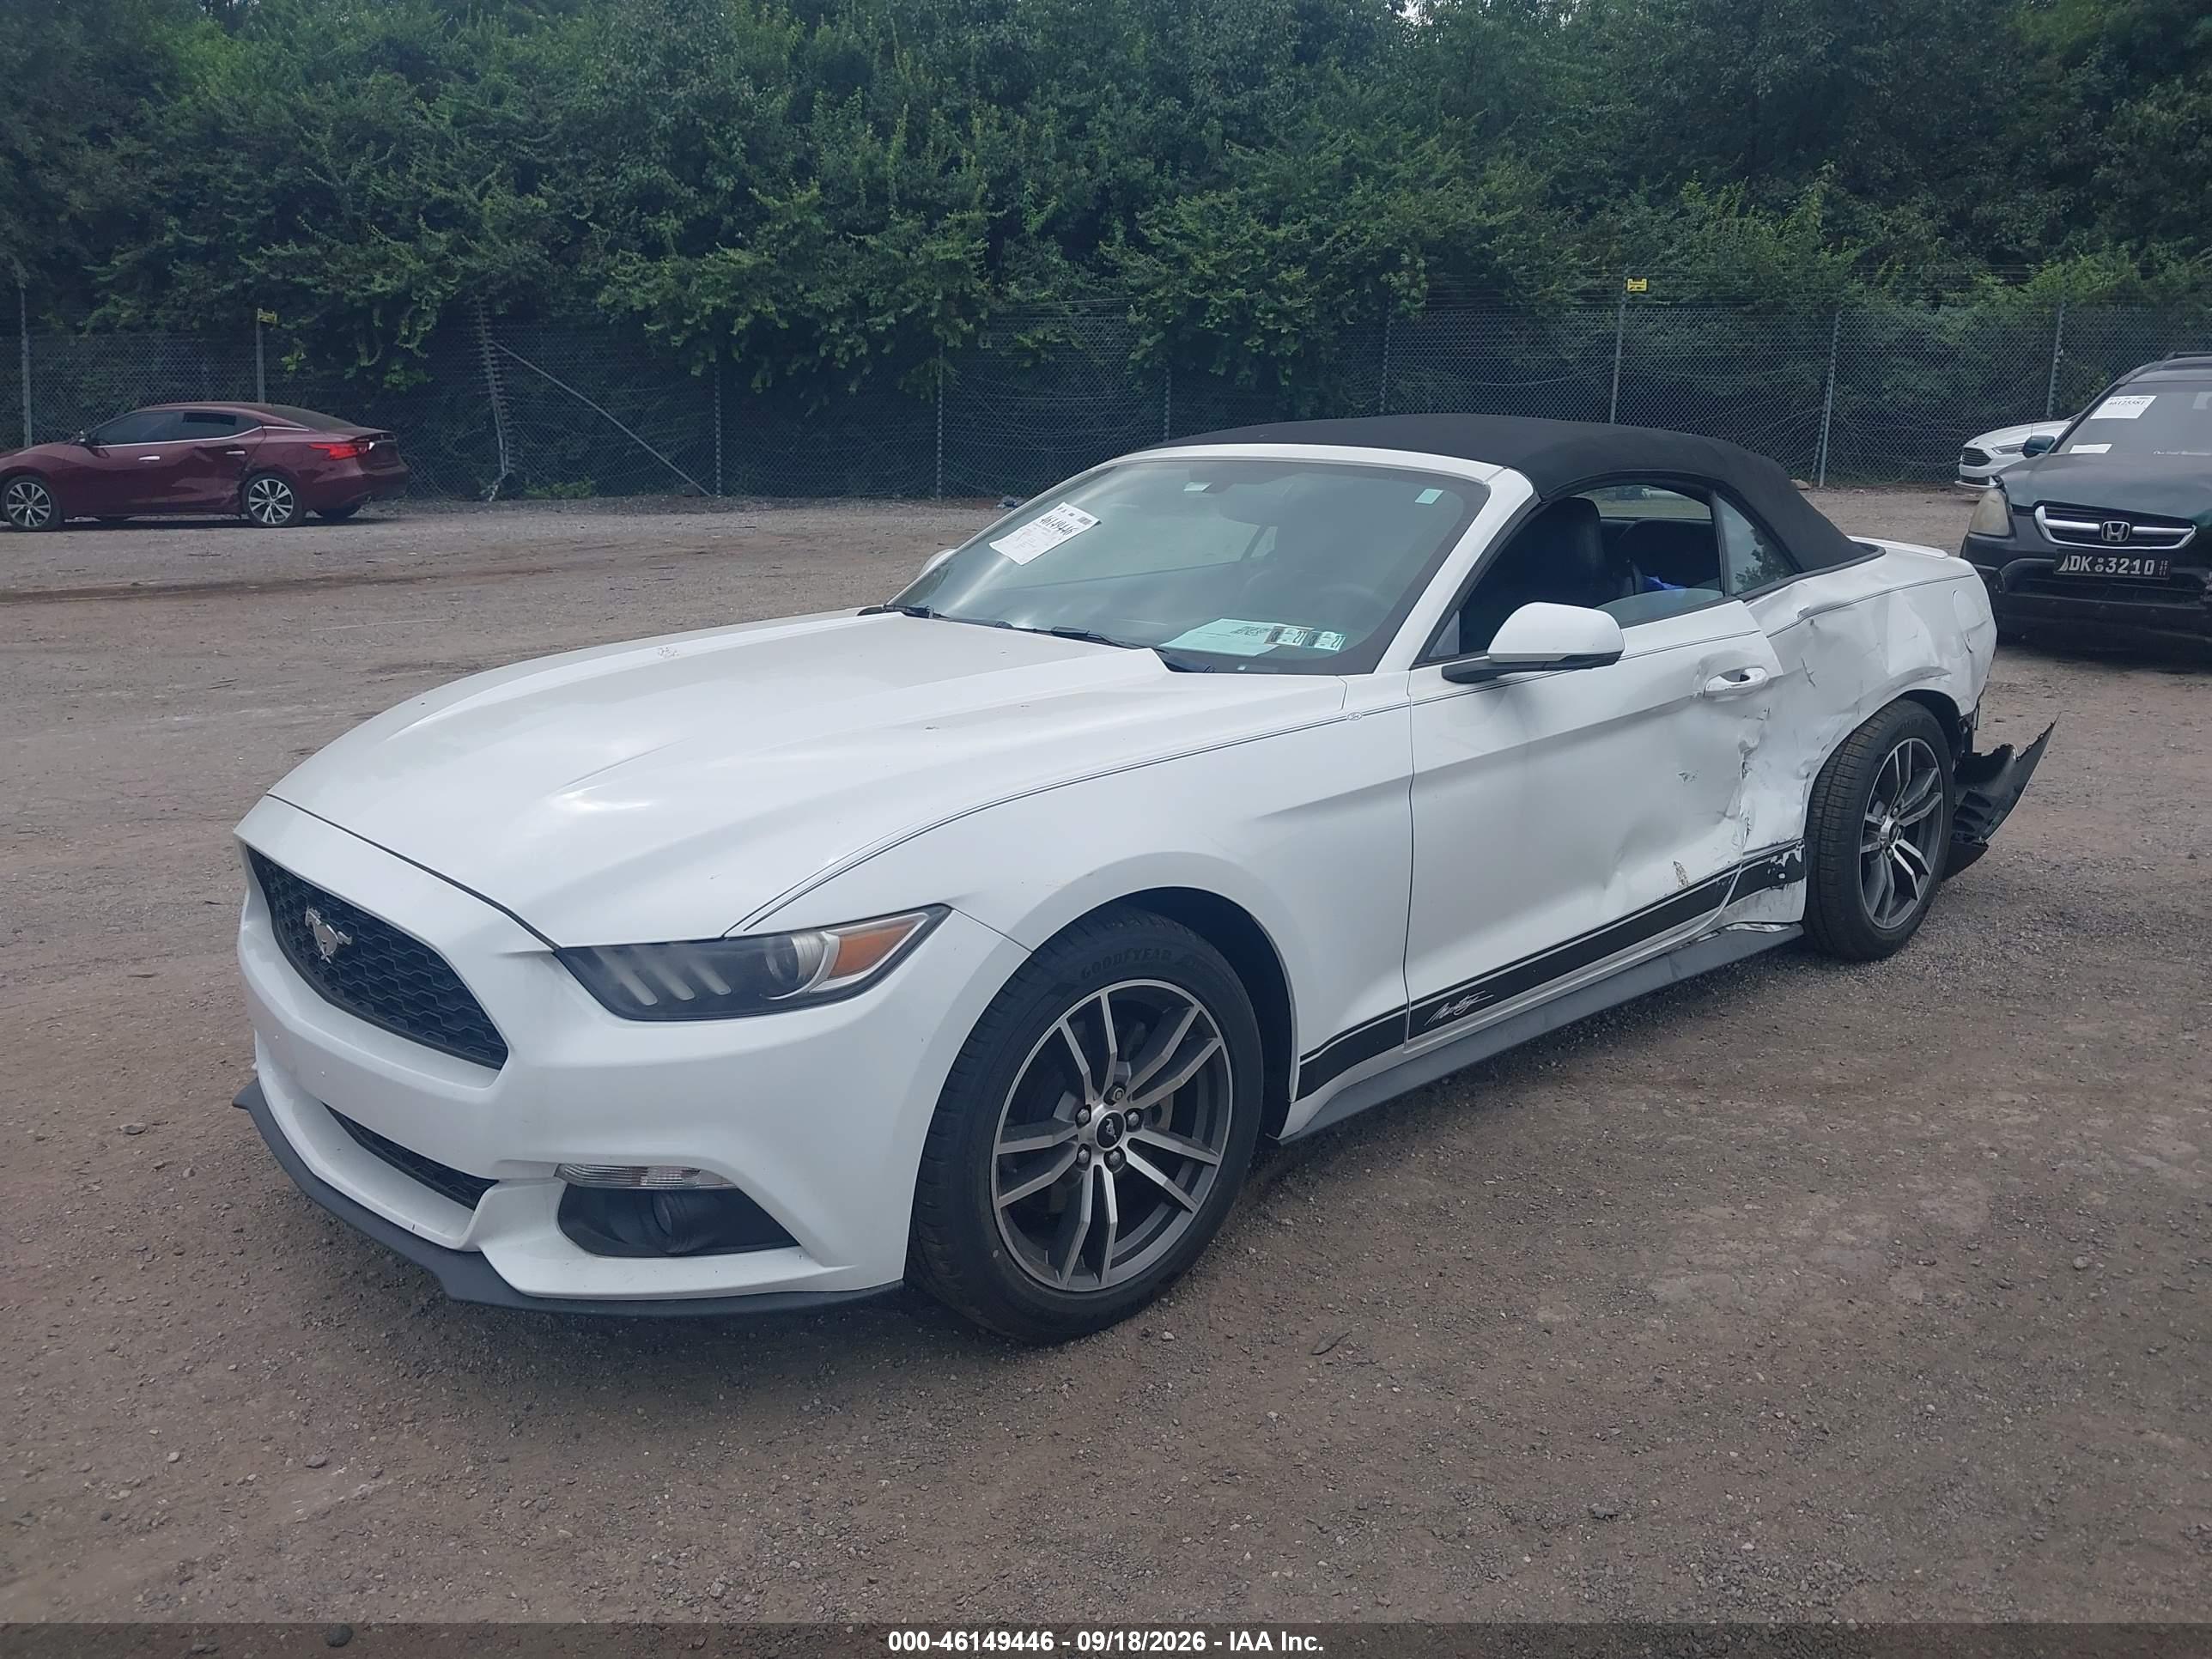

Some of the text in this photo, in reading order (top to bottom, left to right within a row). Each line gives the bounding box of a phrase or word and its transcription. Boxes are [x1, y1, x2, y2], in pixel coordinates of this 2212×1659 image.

[2068, 555, 2093, 572] DK
[2106, 557, 2154, 575] 3210
[1331, 635, 1346, 649] 27
